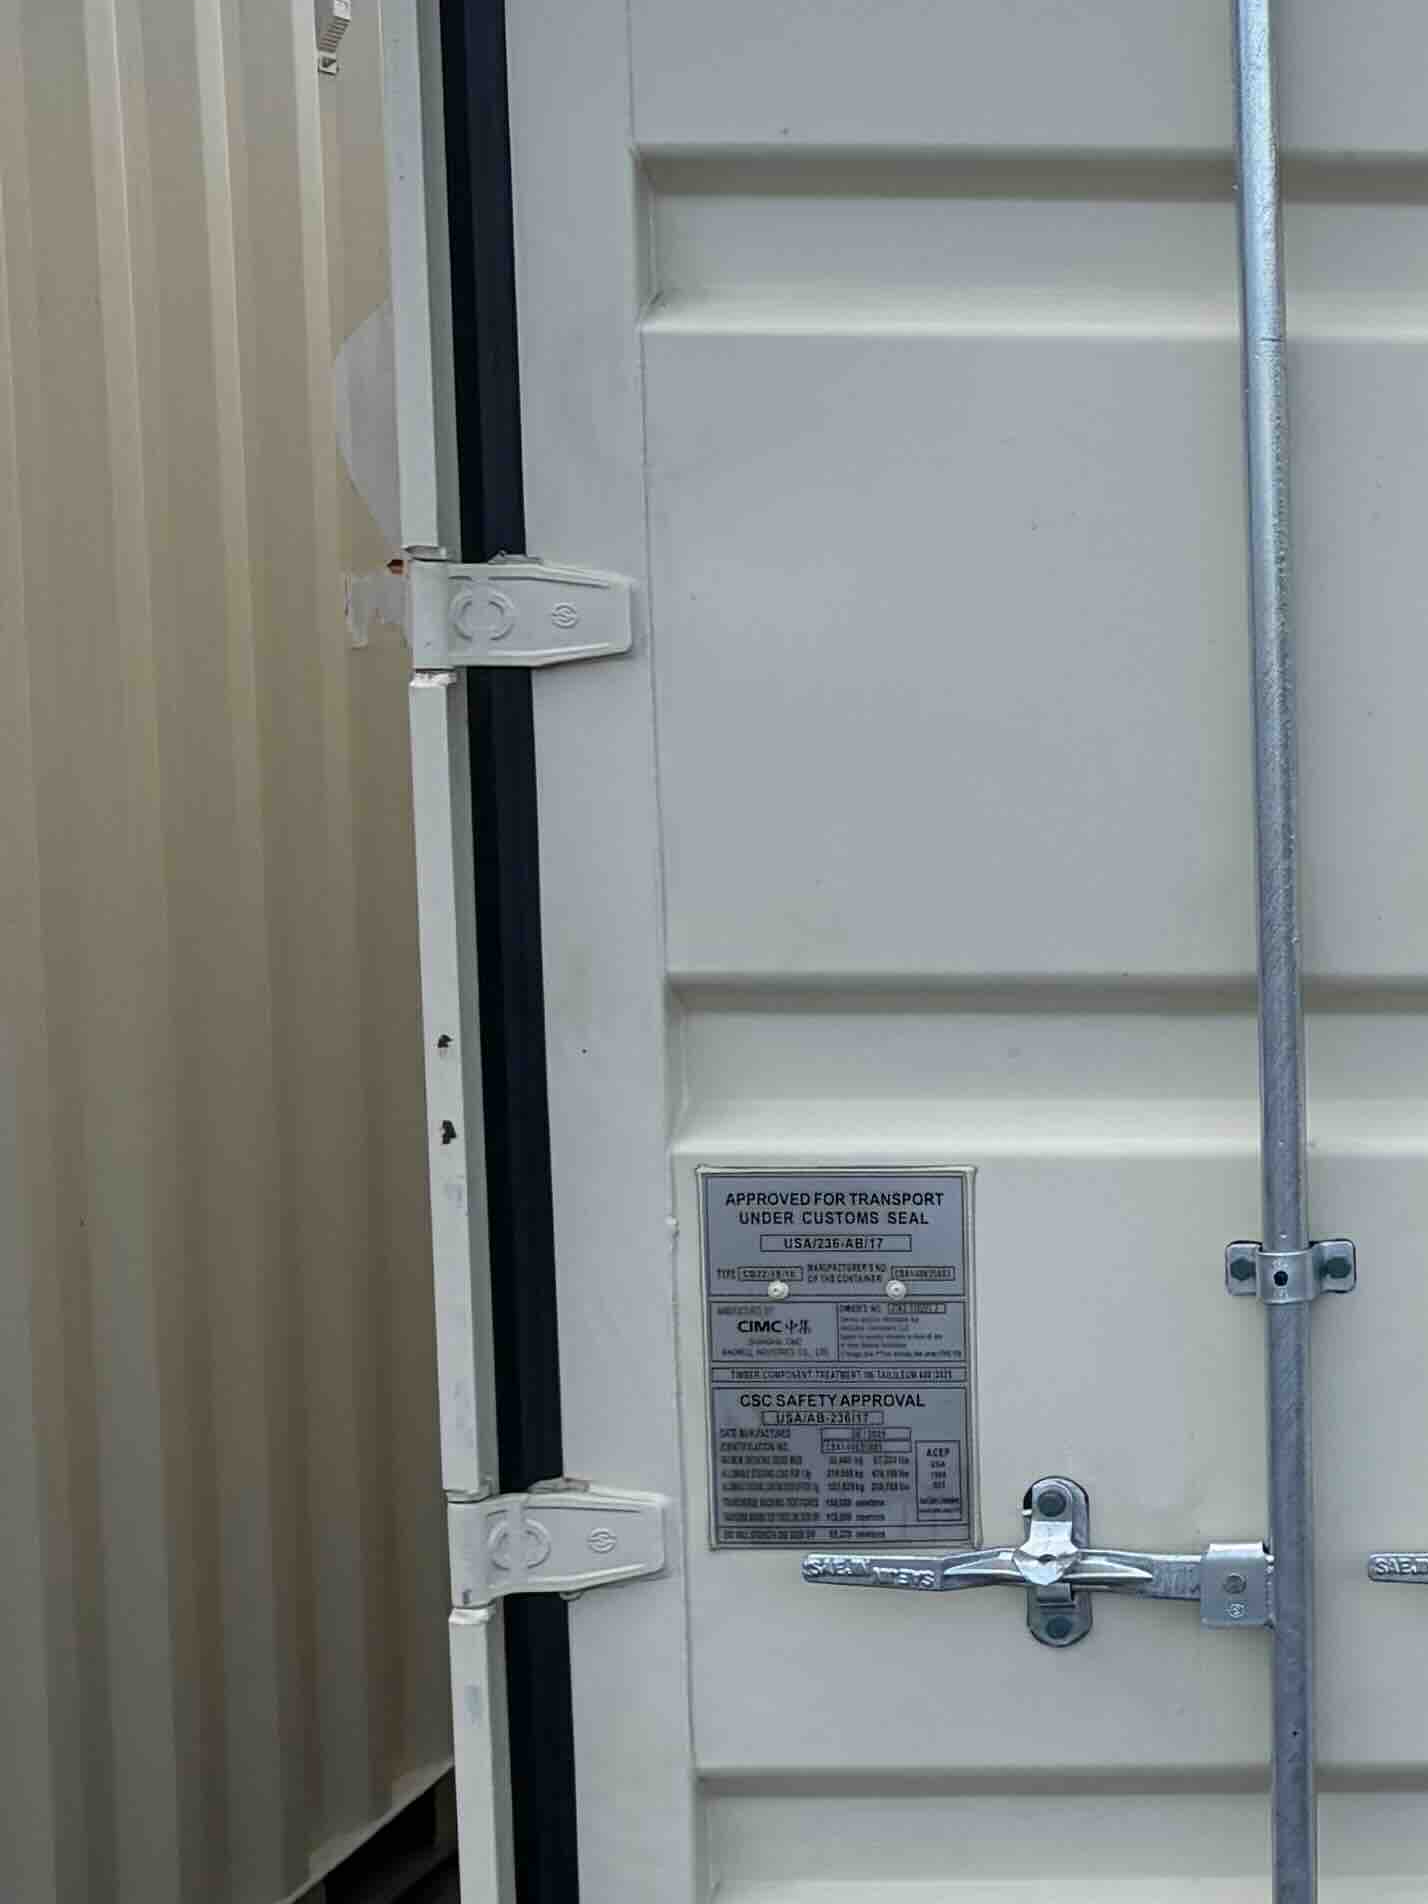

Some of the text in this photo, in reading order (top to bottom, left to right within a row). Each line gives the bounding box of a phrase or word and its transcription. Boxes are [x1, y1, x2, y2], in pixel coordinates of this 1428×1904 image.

[725, 1192, 944, 1206] APPROVED FOR TRANSPORT
[738, 1211, 929, 1225] UNDER CUSTOMS SEAL
[737, 1320, 783, 1333] CIMC
[740, 1393, 926, 1407] CSC SAFETY APPROVAL
